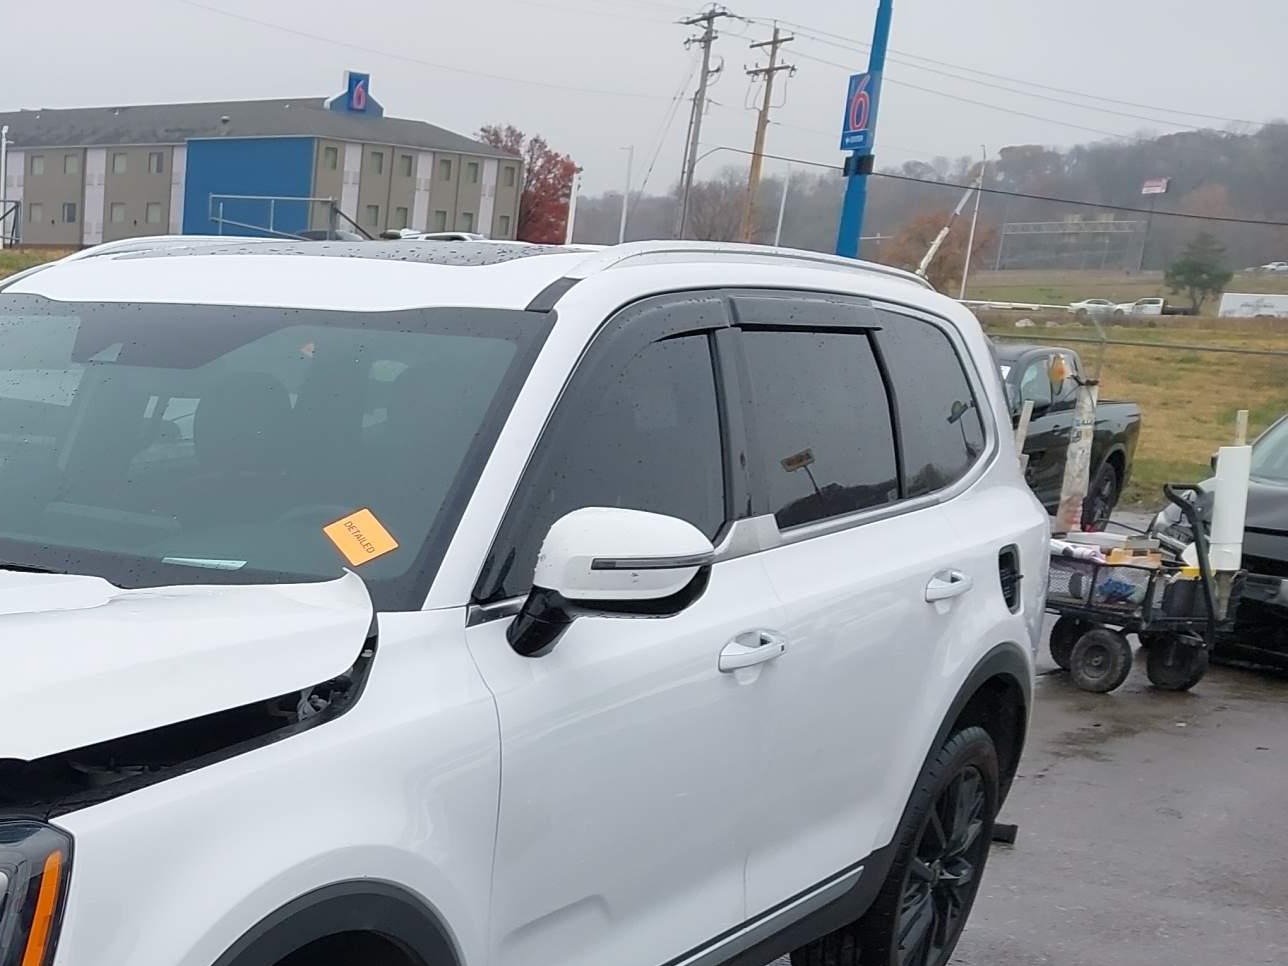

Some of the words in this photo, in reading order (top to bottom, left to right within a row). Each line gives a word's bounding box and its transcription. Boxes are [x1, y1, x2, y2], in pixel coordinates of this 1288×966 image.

[353, 80, 366, 109] 6
[850, 74, 871, 131] 6
[343, 520, 375, 554] DETAILED
